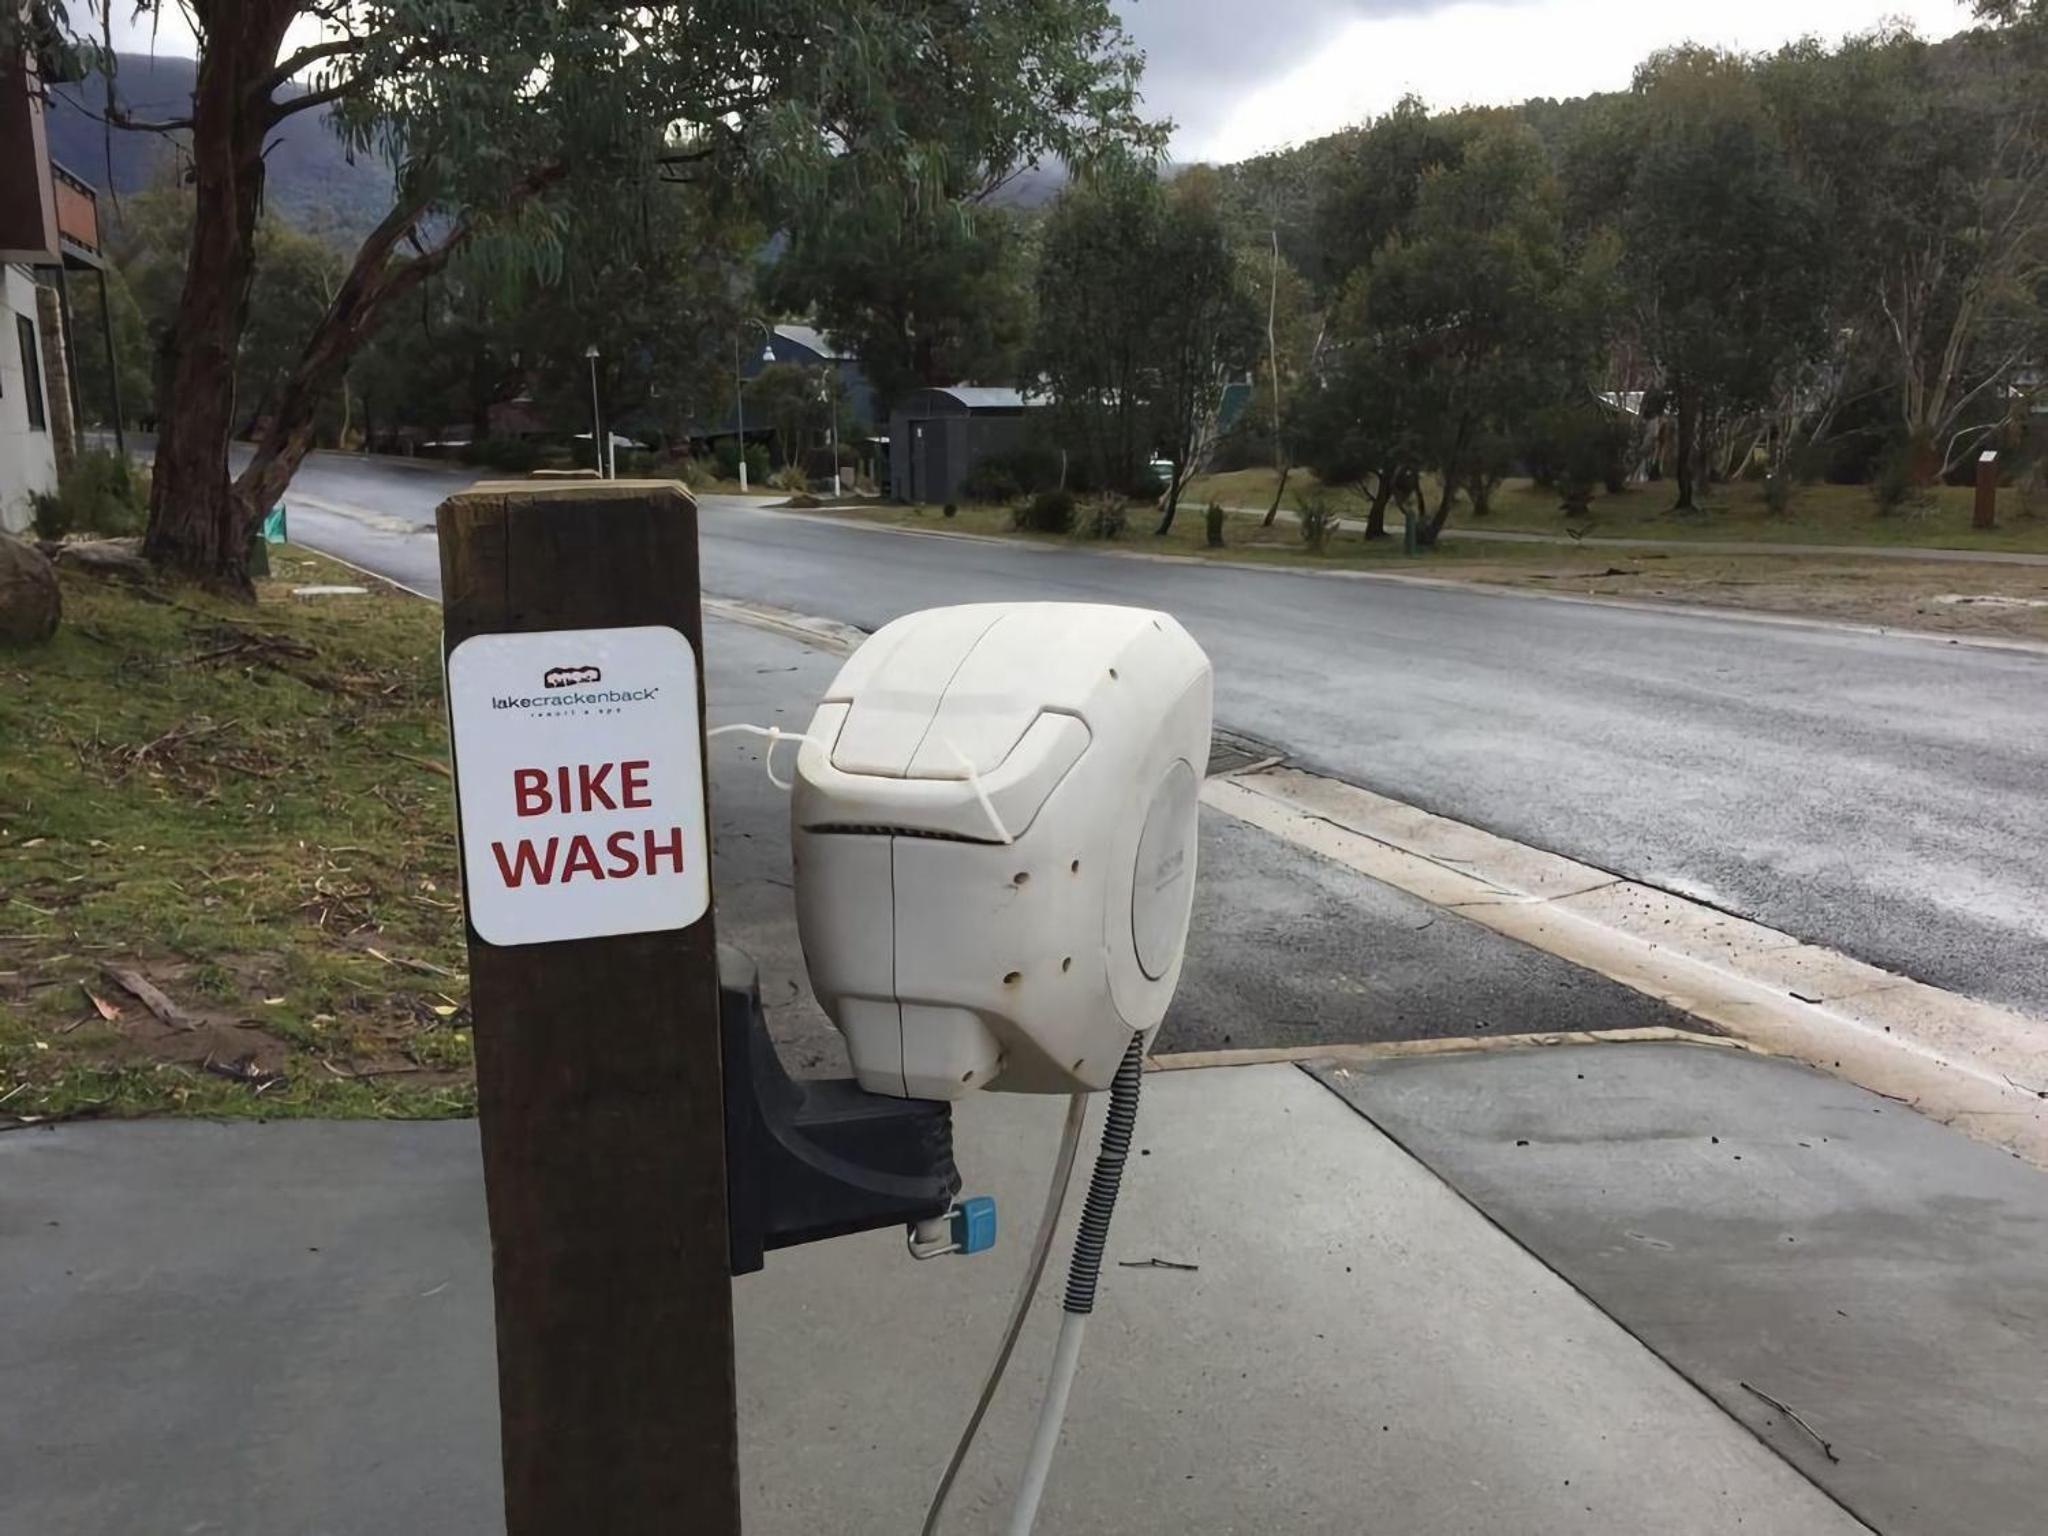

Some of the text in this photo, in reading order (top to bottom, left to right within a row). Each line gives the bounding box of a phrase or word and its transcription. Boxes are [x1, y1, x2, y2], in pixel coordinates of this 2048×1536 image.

[492, 687, 657, 710] lakecrackenback
[514, 760, 651, 816] BIKE
[491, 827, 683, 888] WASH
